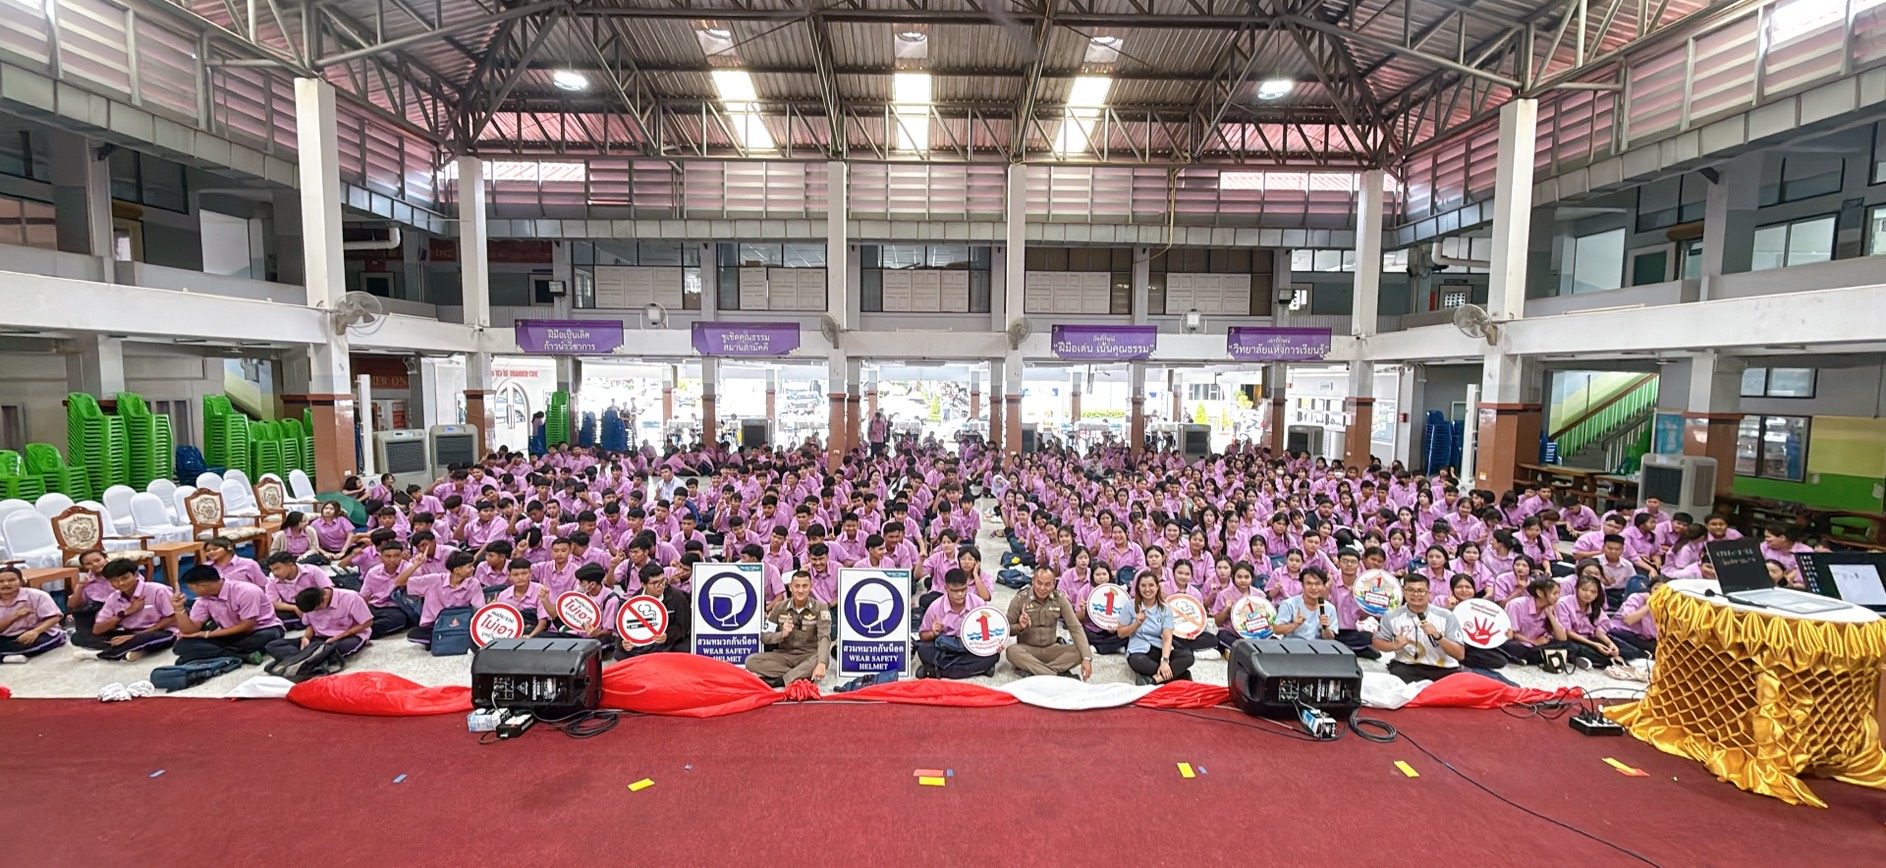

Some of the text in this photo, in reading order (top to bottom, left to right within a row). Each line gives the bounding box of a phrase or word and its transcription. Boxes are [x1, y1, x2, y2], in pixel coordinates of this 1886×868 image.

[547, 328, 590, 339] ฝีมือเป็นเลิศ
[721, 331, 770, 344] ชูเชิดคุณธรรม
[544, 340, 596, 351] ก้าวนำวิชาการ
[562, 597, 588, 620] ไม่เอา
[1103, 591, 1115, 616] 1
[480, 613, 514, 638] ไม่เอา
[976, 614, 990, 641] 1
[702, 647, 752, 655] WEAR SAFETY
[849, 654, 899, 663] WEAR SAFETY
[859, 662, 889, 670] HELMET
